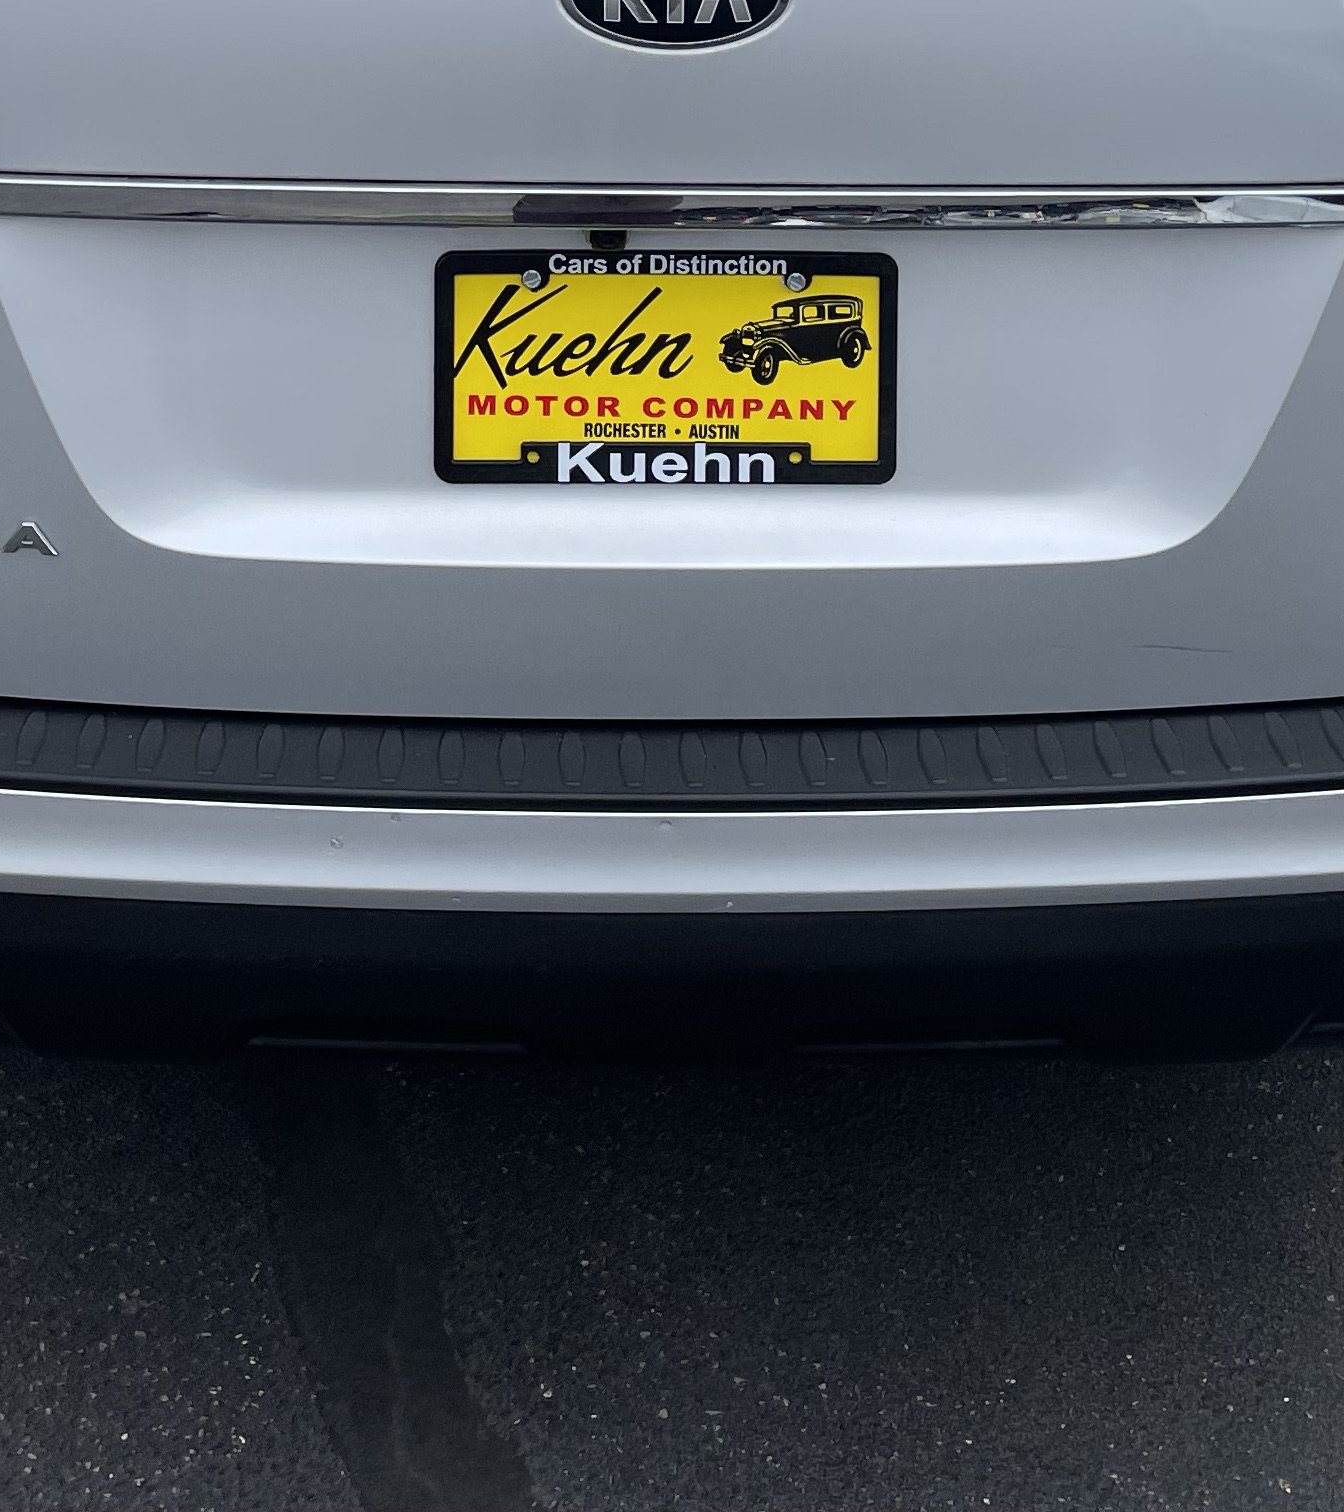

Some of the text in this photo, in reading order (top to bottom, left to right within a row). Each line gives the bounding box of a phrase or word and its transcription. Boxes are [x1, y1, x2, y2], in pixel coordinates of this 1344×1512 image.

[548, 254, 787, 275] Cars of Distinction
[454, 284, 694, 390] Kuehn
[467, 394, 857, 421] MOTOR COMPANY
[583, 422, 740, 440] ROCHESTER AUSTIN
[557, 441, 775, 484] Kuehn
